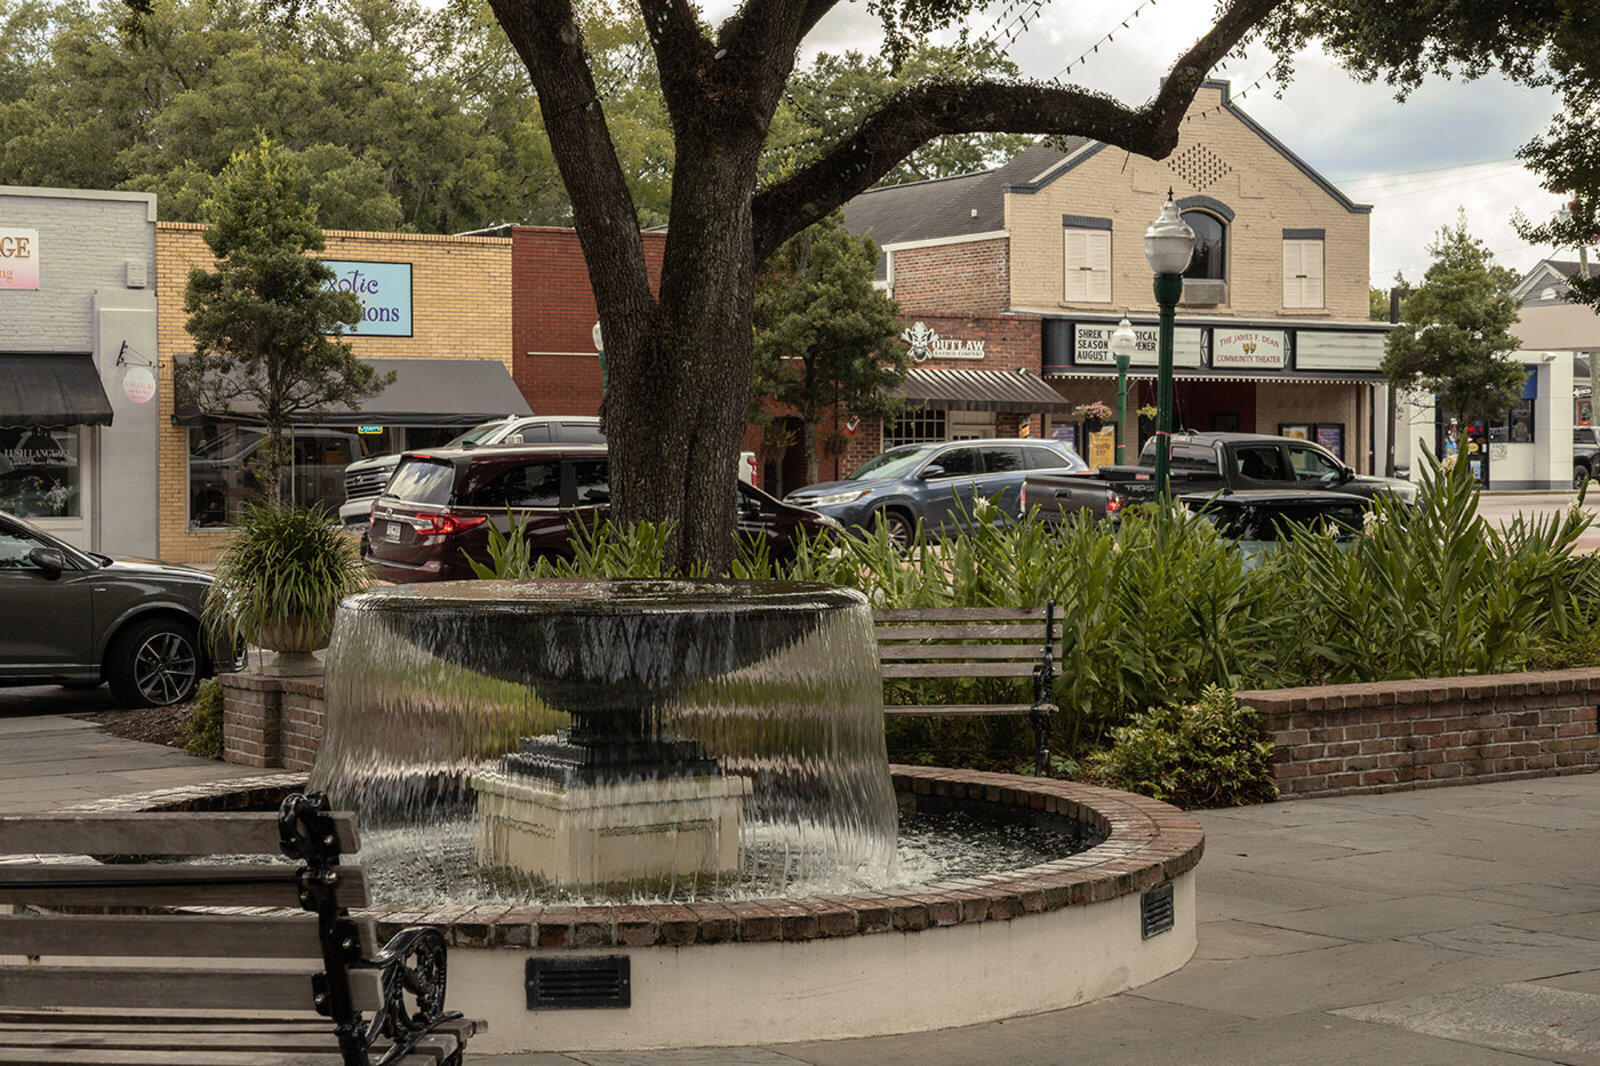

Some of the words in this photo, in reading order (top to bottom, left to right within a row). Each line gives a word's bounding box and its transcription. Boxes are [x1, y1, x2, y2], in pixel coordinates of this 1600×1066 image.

[0, 236, 30, 258] GE
[323, 269, 379, 294] xotic
[361, 300, 400, 322] ions
[1078, 329, 1103, 339] SHREK
[1135, 331, 1157, 341] SICAL
[1220, 335, 1232, 346] THE
[1233, 333, 1254, 344] JAMES
[1261, 335, 1280, 347] DEAN
[932, 339, 985, 351] OUTLAW
[1077, 340, 1109, 350] SEASON
[1135, 342, 1156, 351] ENER
[1077, 351, 1108, 361] AUGUST
[1217, 355, 1253, 363] COMMUNITY
[1254, 355, 1281, 363] THEATER
